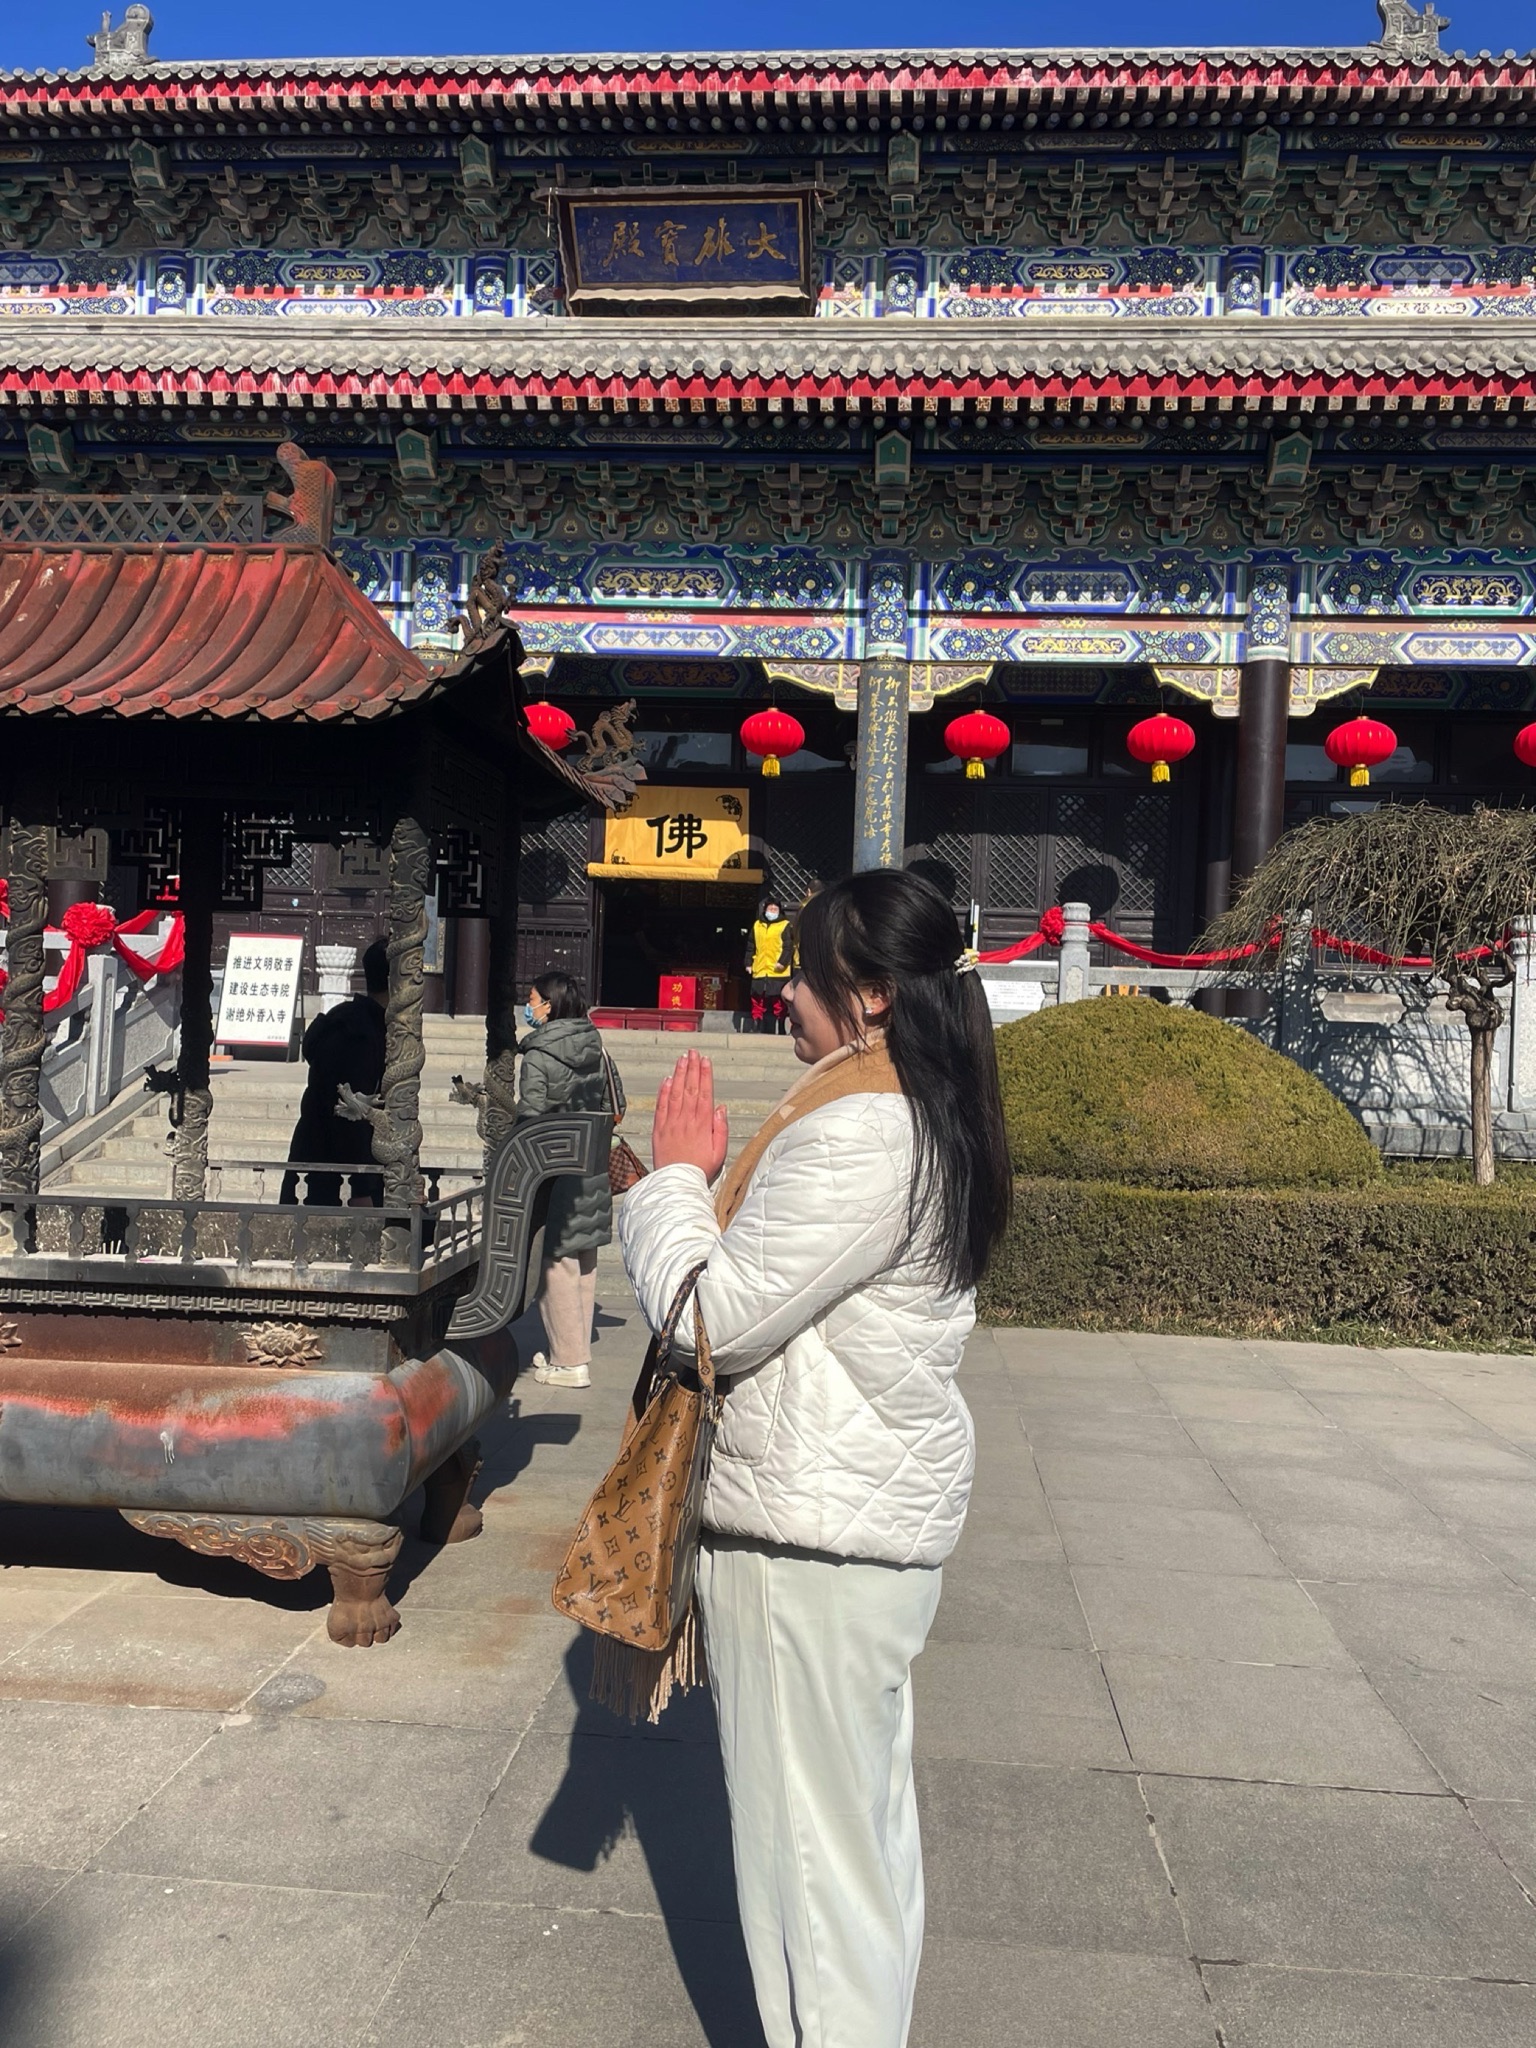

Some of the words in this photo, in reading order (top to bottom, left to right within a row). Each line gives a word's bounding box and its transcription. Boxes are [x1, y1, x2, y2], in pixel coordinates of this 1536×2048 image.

[602, 217, 787, 268] 大雄寶殿
[646, 813, 708, 859] 佛
[232, 955, 294, 972] 推进文明敬香
[228, 981, 291, 998] 建设生态寺院
[671, 982, 683, 1010] 功德
[225, 1007, 287, 1024] 谢绝外香入寺
